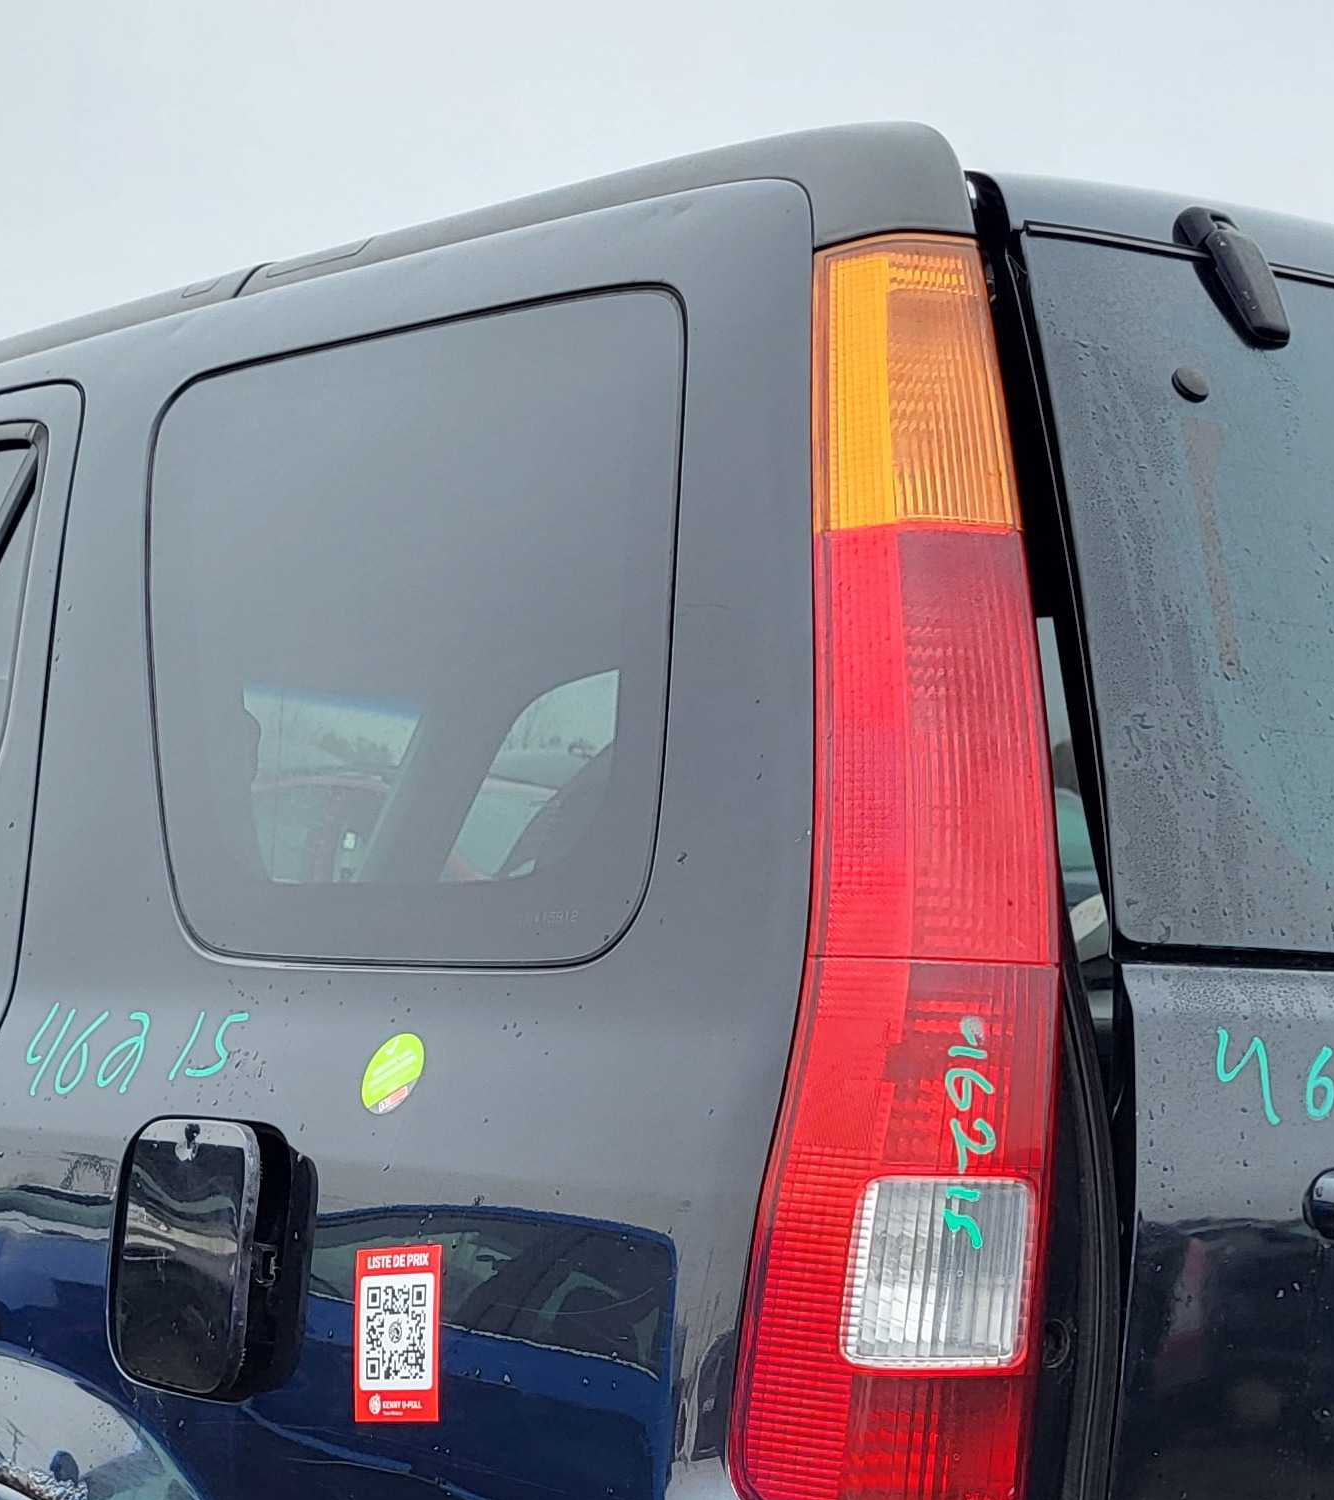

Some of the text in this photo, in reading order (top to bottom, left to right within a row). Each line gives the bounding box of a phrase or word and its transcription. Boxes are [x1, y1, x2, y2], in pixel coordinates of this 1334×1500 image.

[367, 1252, 430, 1270] LISTE DE PRIX
